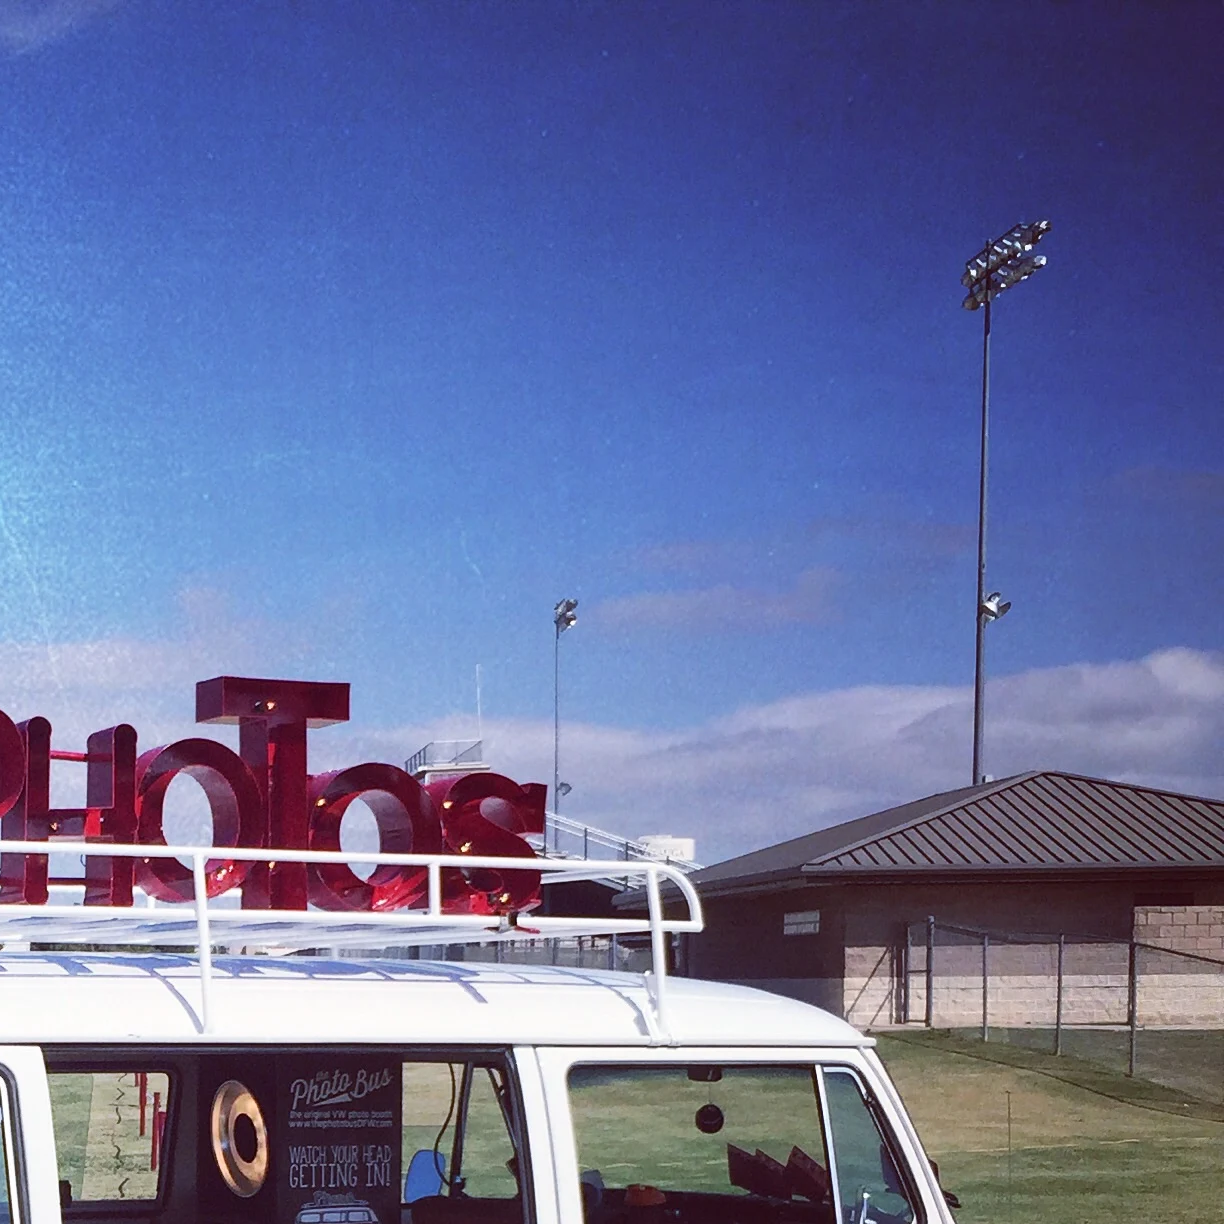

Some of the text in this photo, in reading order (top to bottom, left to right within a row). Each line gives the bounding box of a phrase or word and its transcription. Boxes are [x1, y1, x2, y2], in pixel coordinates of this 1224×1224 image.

[290, 1068, 394, 1110] Photo Bus
[288, 1144, 392, 1164] WATCH YOUR HEAD
[289, 1163, 391, 1188] GETTING IN!
